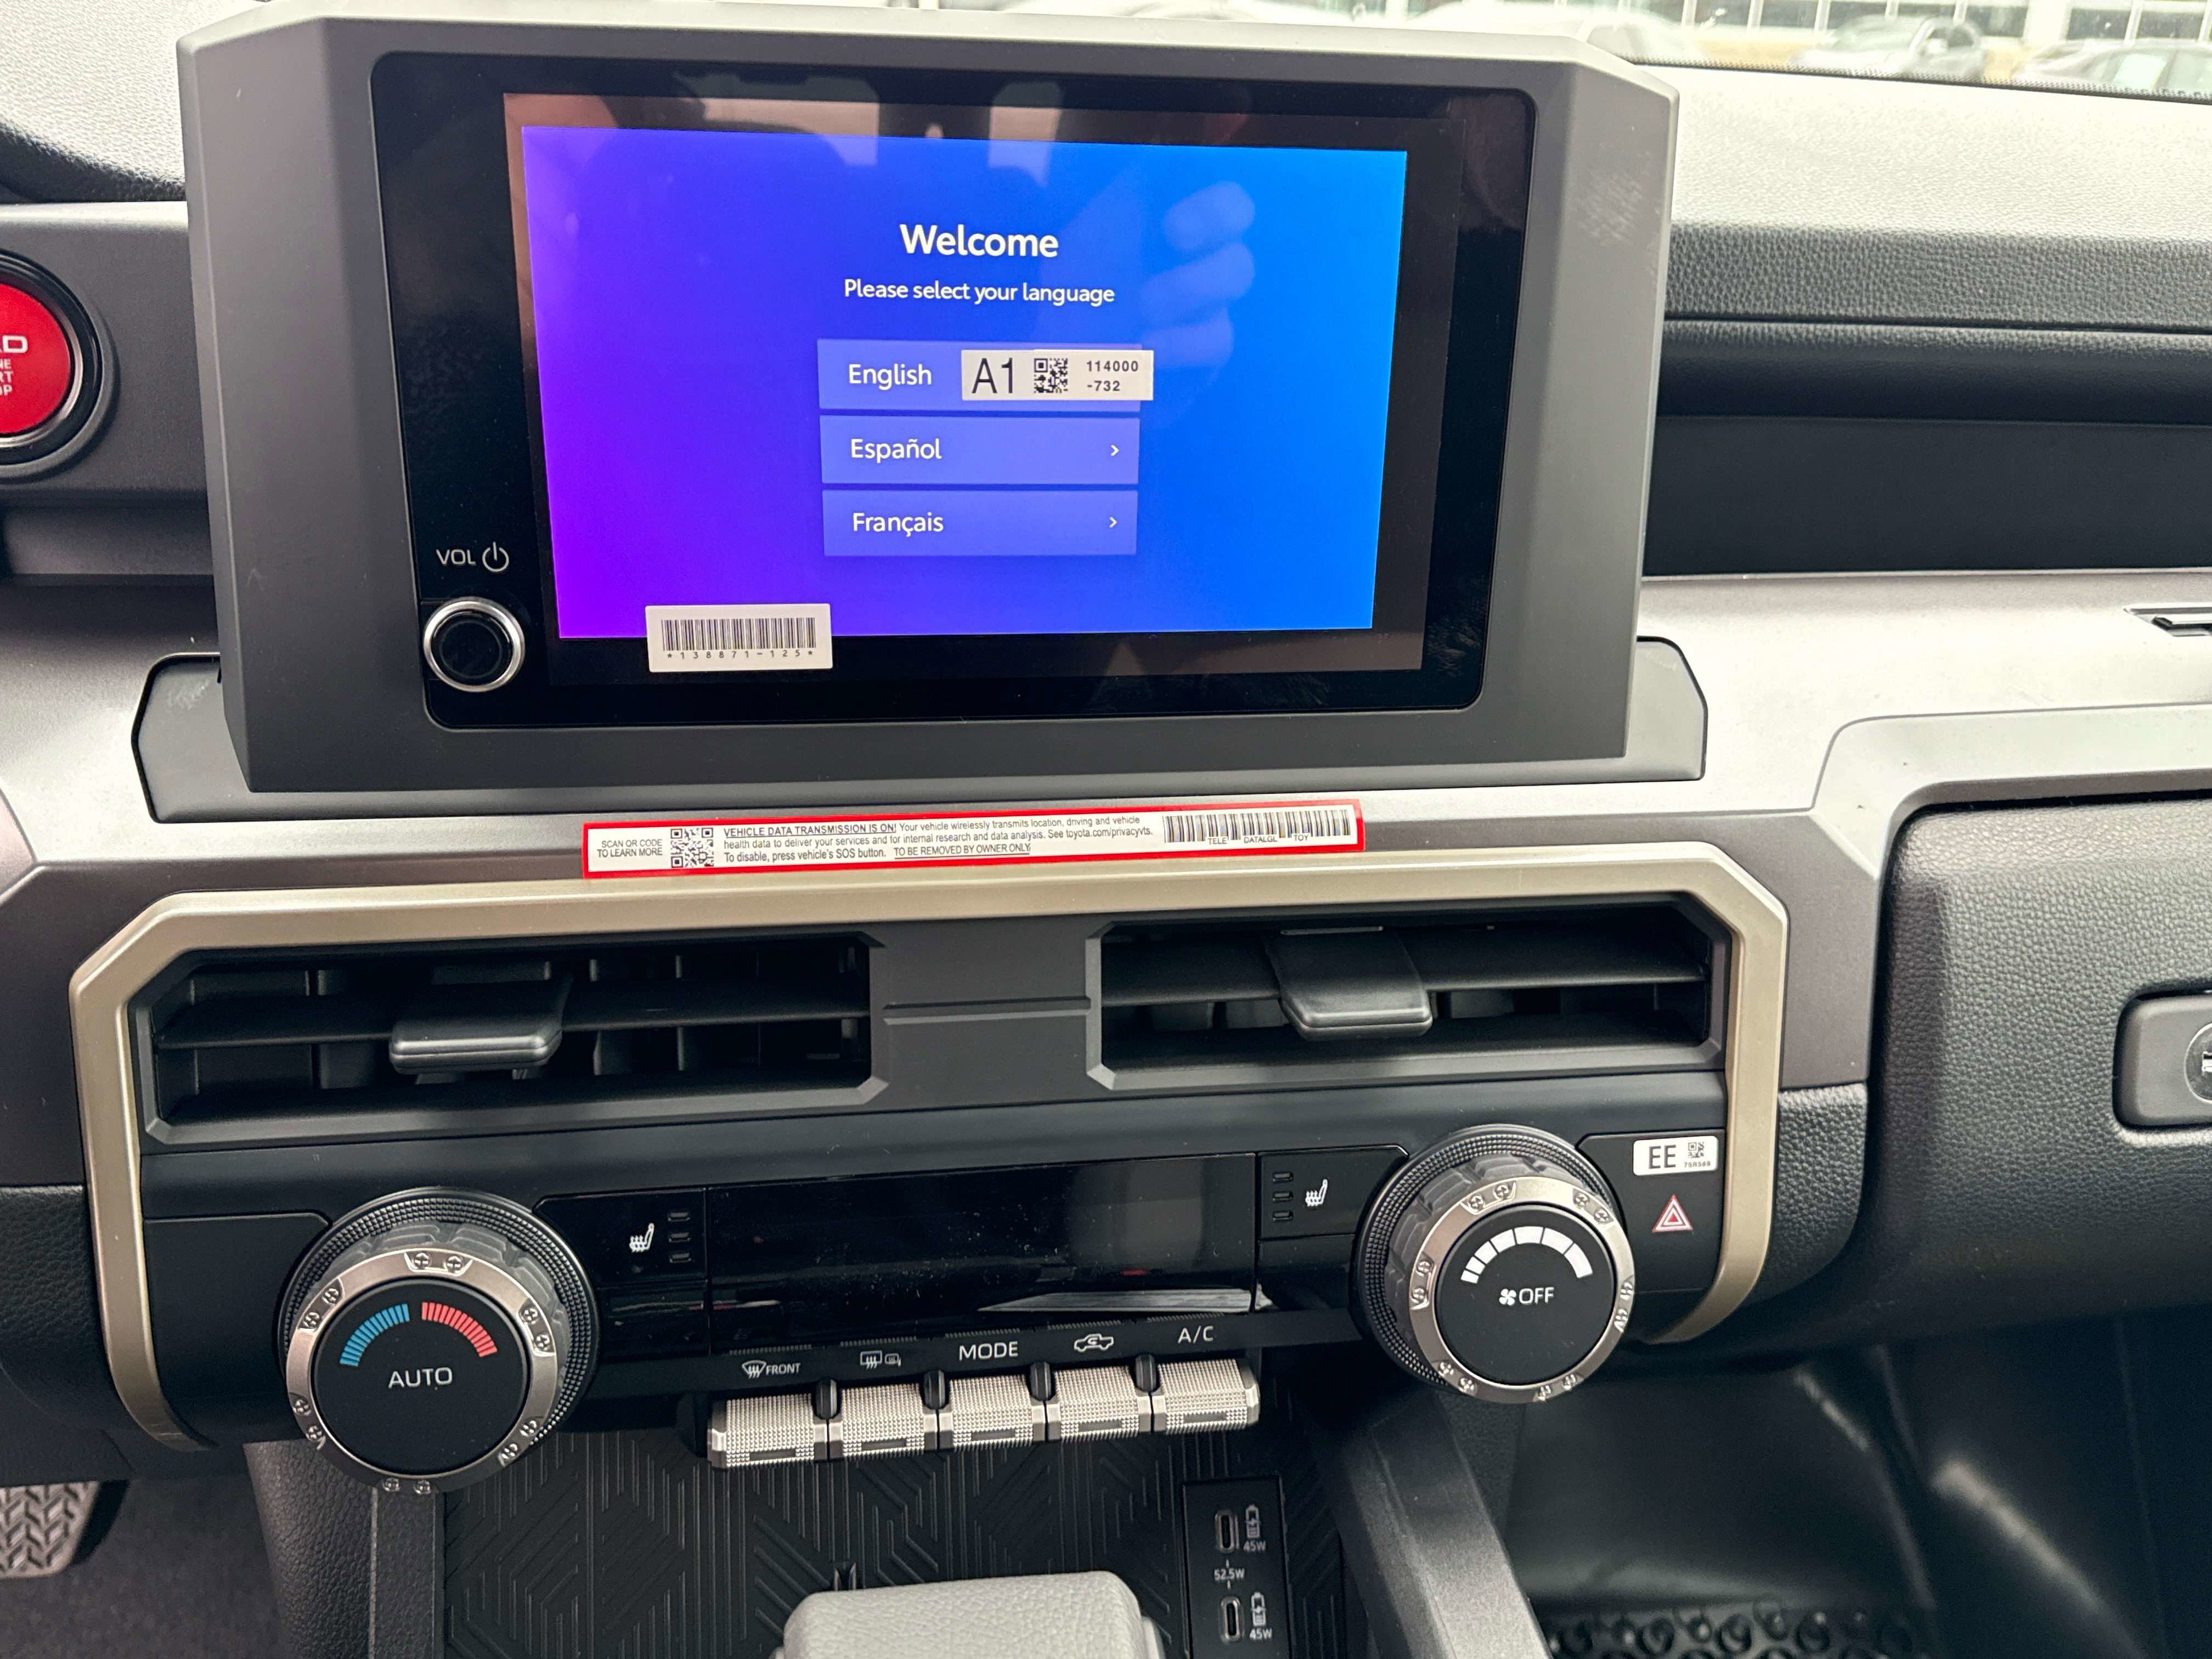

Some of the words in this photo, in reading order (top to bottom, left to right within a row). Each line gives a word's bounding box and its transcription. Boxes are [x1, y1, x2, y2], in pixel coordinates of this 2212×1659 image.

[900, 224, 1059, 257] Welcome
[845, 278, 909, 298] Please
[913, 280, 970, 300] select
[974, 284, 1018, 305] your
[1023, 282, 1115, 307] language
[972, 358, 1013, 393] A1
[1087, 360, 1139, 372] 114000
[849, 363, 932, 391] English
[1087, 380, 1120, 392] -732
[851, 438, 943, 464] Español
[853, 512, 944, 537] Français
[436, 549, 476, 566] VOL
[724, 827, 765, 837] VEHICLE
[768, 826, 793, 836] DATA
[794, 824, 866, 834] TRANSMISSION
[868, 824, 878, 832] IS
[899, 823, 918, 831] Your
[920, 822, 949, 831] vehicle
[951, 822, 990, 830] wirelessly
[992, 820, 1029, 828] transmits
[1031, 819, 1064, 829] location,
[1066, 819, 1093, 827] driving
[1096, 817, 1110, 825] and
[601, 840, 624, 848] SCAN
[640, 839, 662, 847] CODE
[724, 840, 750, 849] health
[752, 840, 771, 848] data
[785, 839, 812, 847] deliver
[815, 839, 833, 849] your
[872, 836, 888, 844] and
[889, 835, 901, 844] for
[904, 834, 933, 843] internal
[936, 833, 971, 842] research
[973, 832, 989, 841] and
[991, 832, 1008, 840] data
[1011, 831, 1045, 842] analysis.
[1048, 830, 1064, 839] See
[596, 849, 608, 857] TO
[610, 848, 637, 857] LEARN
[639, 848, 663, 856] MORE
[724, 853, 735, 862] To
[737, 851, 770, 862] disable,
[772, 853, 795, 863] press
[836, 848, 856, 859] SOS
[857, 848, 886, 858] button.
[893, 847, 906, 856] TO
[907, 847, 918, 856] BE
[921, 845, 962, 855] REMOVED
[963, 845, 974, 854] BY
[976, 844, 1008, 853] OWNER
[1649, 1144, 1677, 1169] EE
[1519, 1286, 1554, 1305] OFF
[1178, 1325, 1214, 1344] A/C
[959, 1341, 1018, 1361] MODE
[388, 1367, 453, 1389] AUTO
[766, 1362, 800, 1376] FRONT
[1243, 1541, 1266, 1551] 45W
[1214, 1568, 1245, 1581] 52.5W
[1249, 1628, 1273, 1640] 45W
